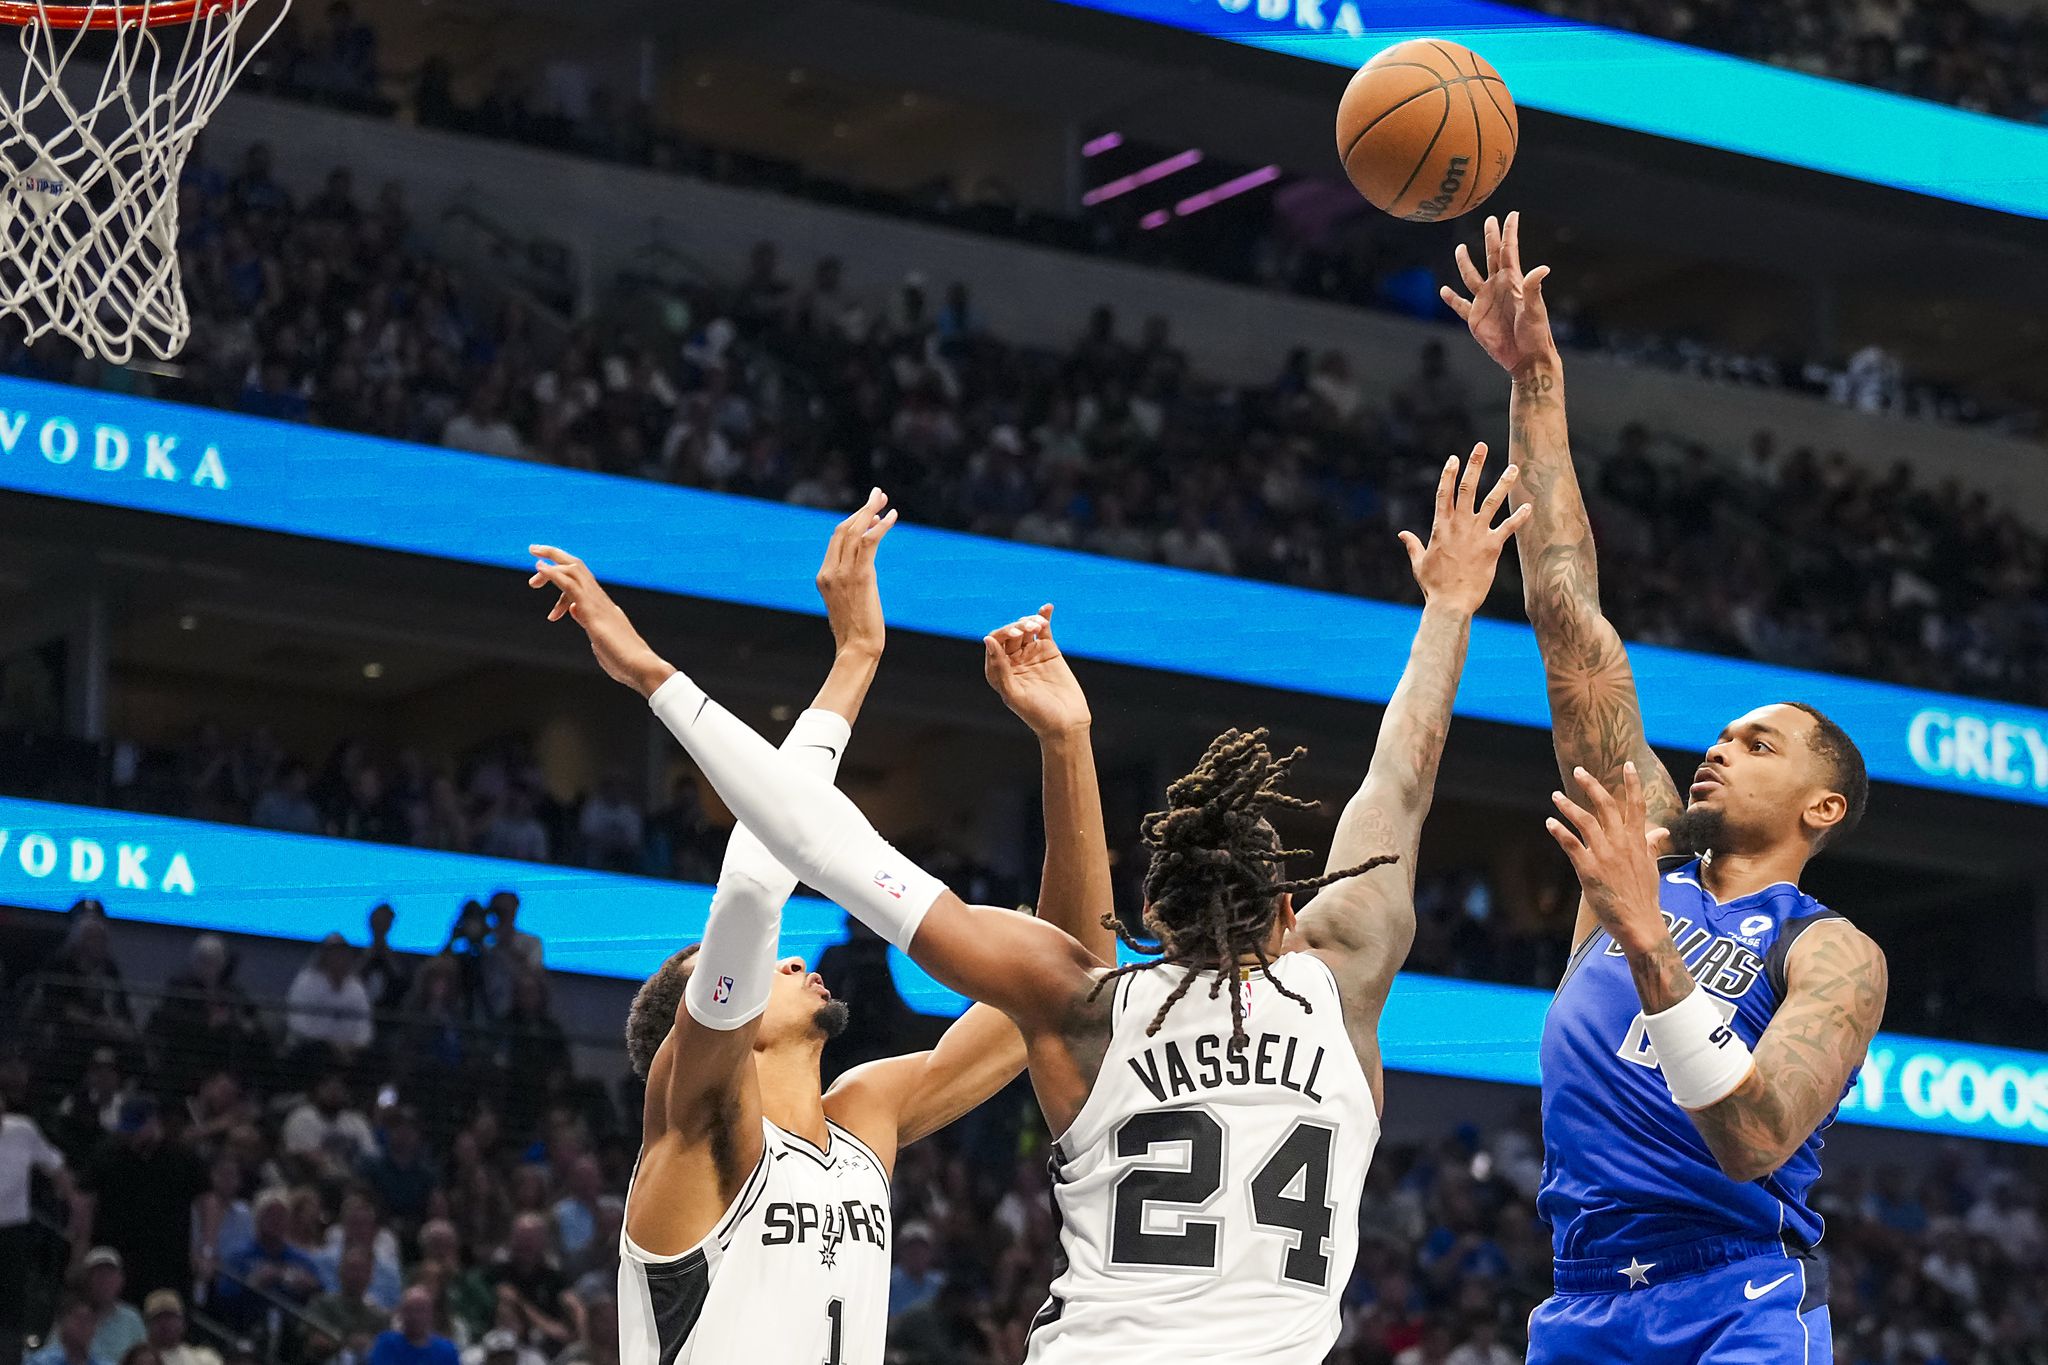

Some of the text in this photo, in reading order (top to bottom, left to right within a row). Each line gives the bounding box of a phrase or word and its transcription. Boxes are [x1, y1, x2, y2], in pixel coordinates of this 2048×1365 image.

[1127, 1033, 1325, 1104] VASSELL
[762, 1200, 885, 1270] SPURS
[1103, 1103, 1341, 1297] 24
[822, 1295, 849, 1365] 1
